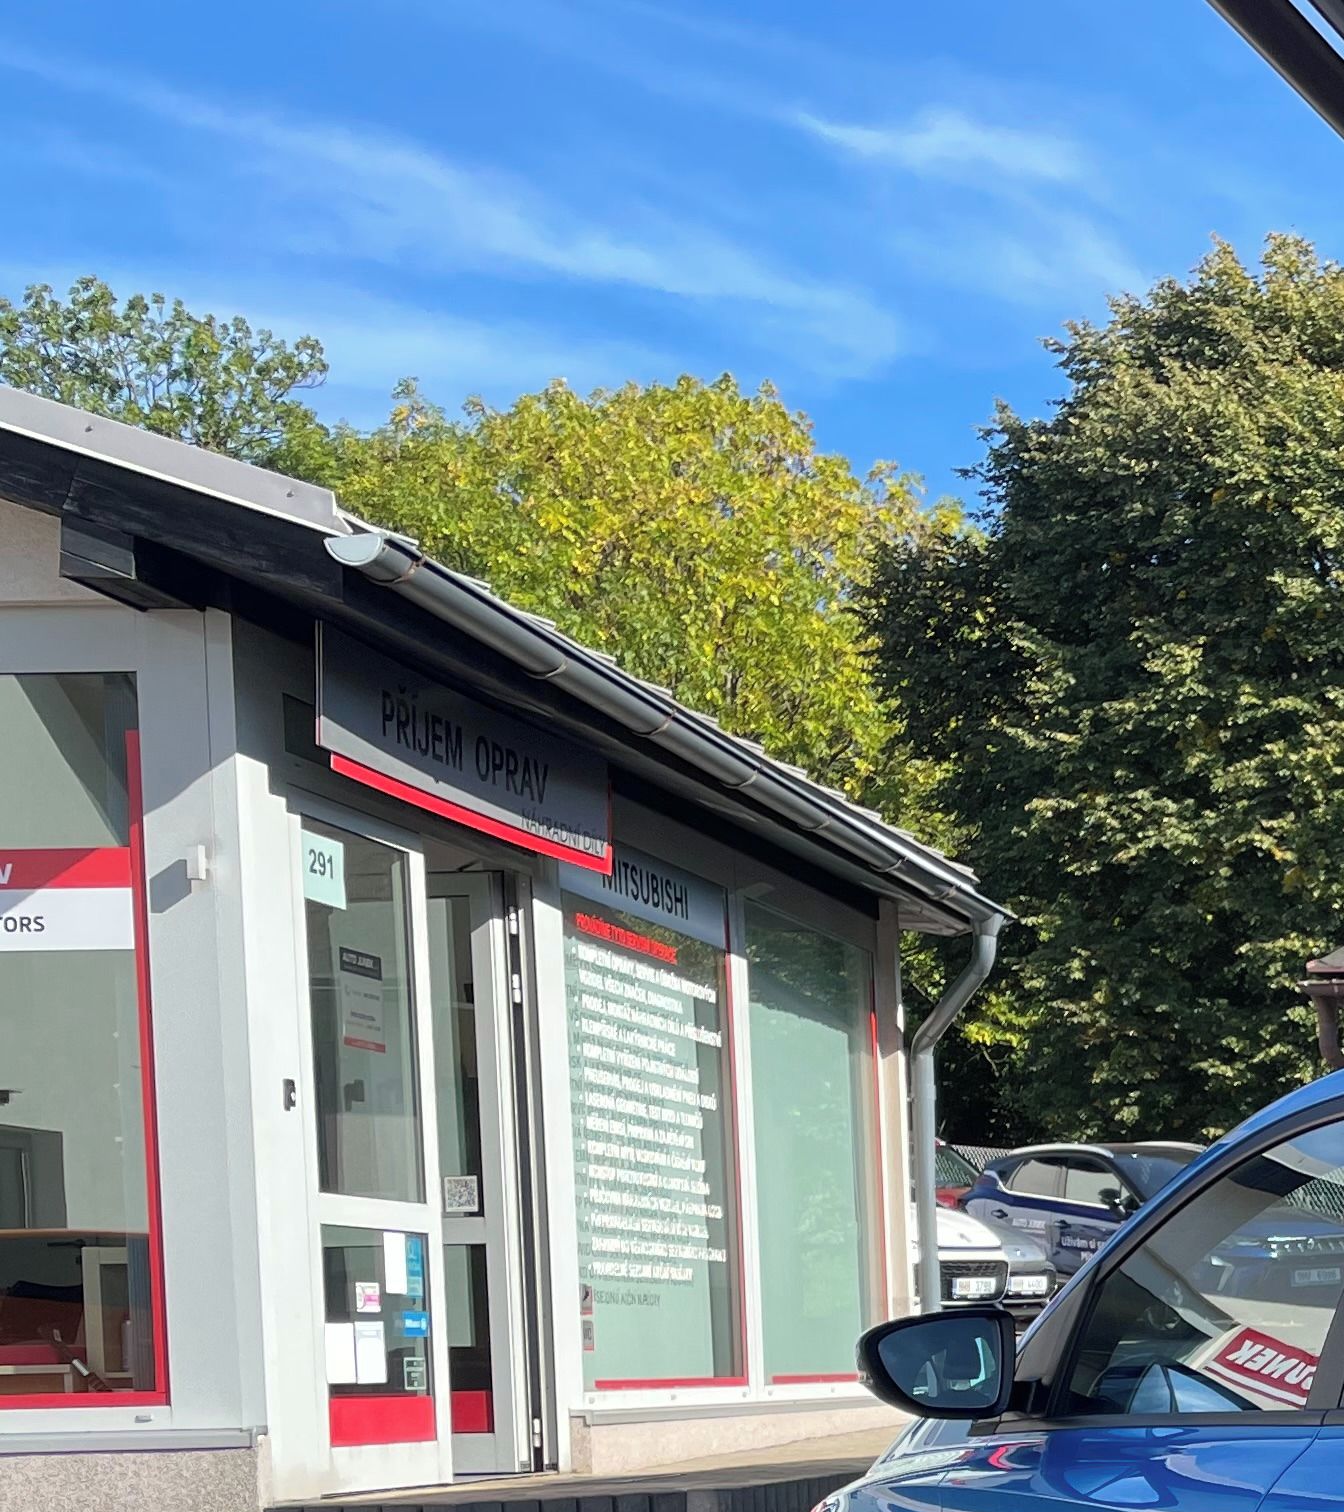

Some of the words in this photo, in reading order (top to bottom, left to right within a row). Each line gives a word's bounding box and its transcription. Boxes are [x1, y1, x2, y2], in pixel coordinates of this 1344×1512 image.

[381, 687, 463, 772] PŘÍJEM
[475, 735, 548, 804] OPRAV
[521, 808, 583, 844] NÁHRADNÍ
[584, 825, 607, 856] DÍLY
[309, 849, 333, 879] 291
[602, 858, 689, 920] MITSUBISHI
[0, 916, 45, 933] ORS
